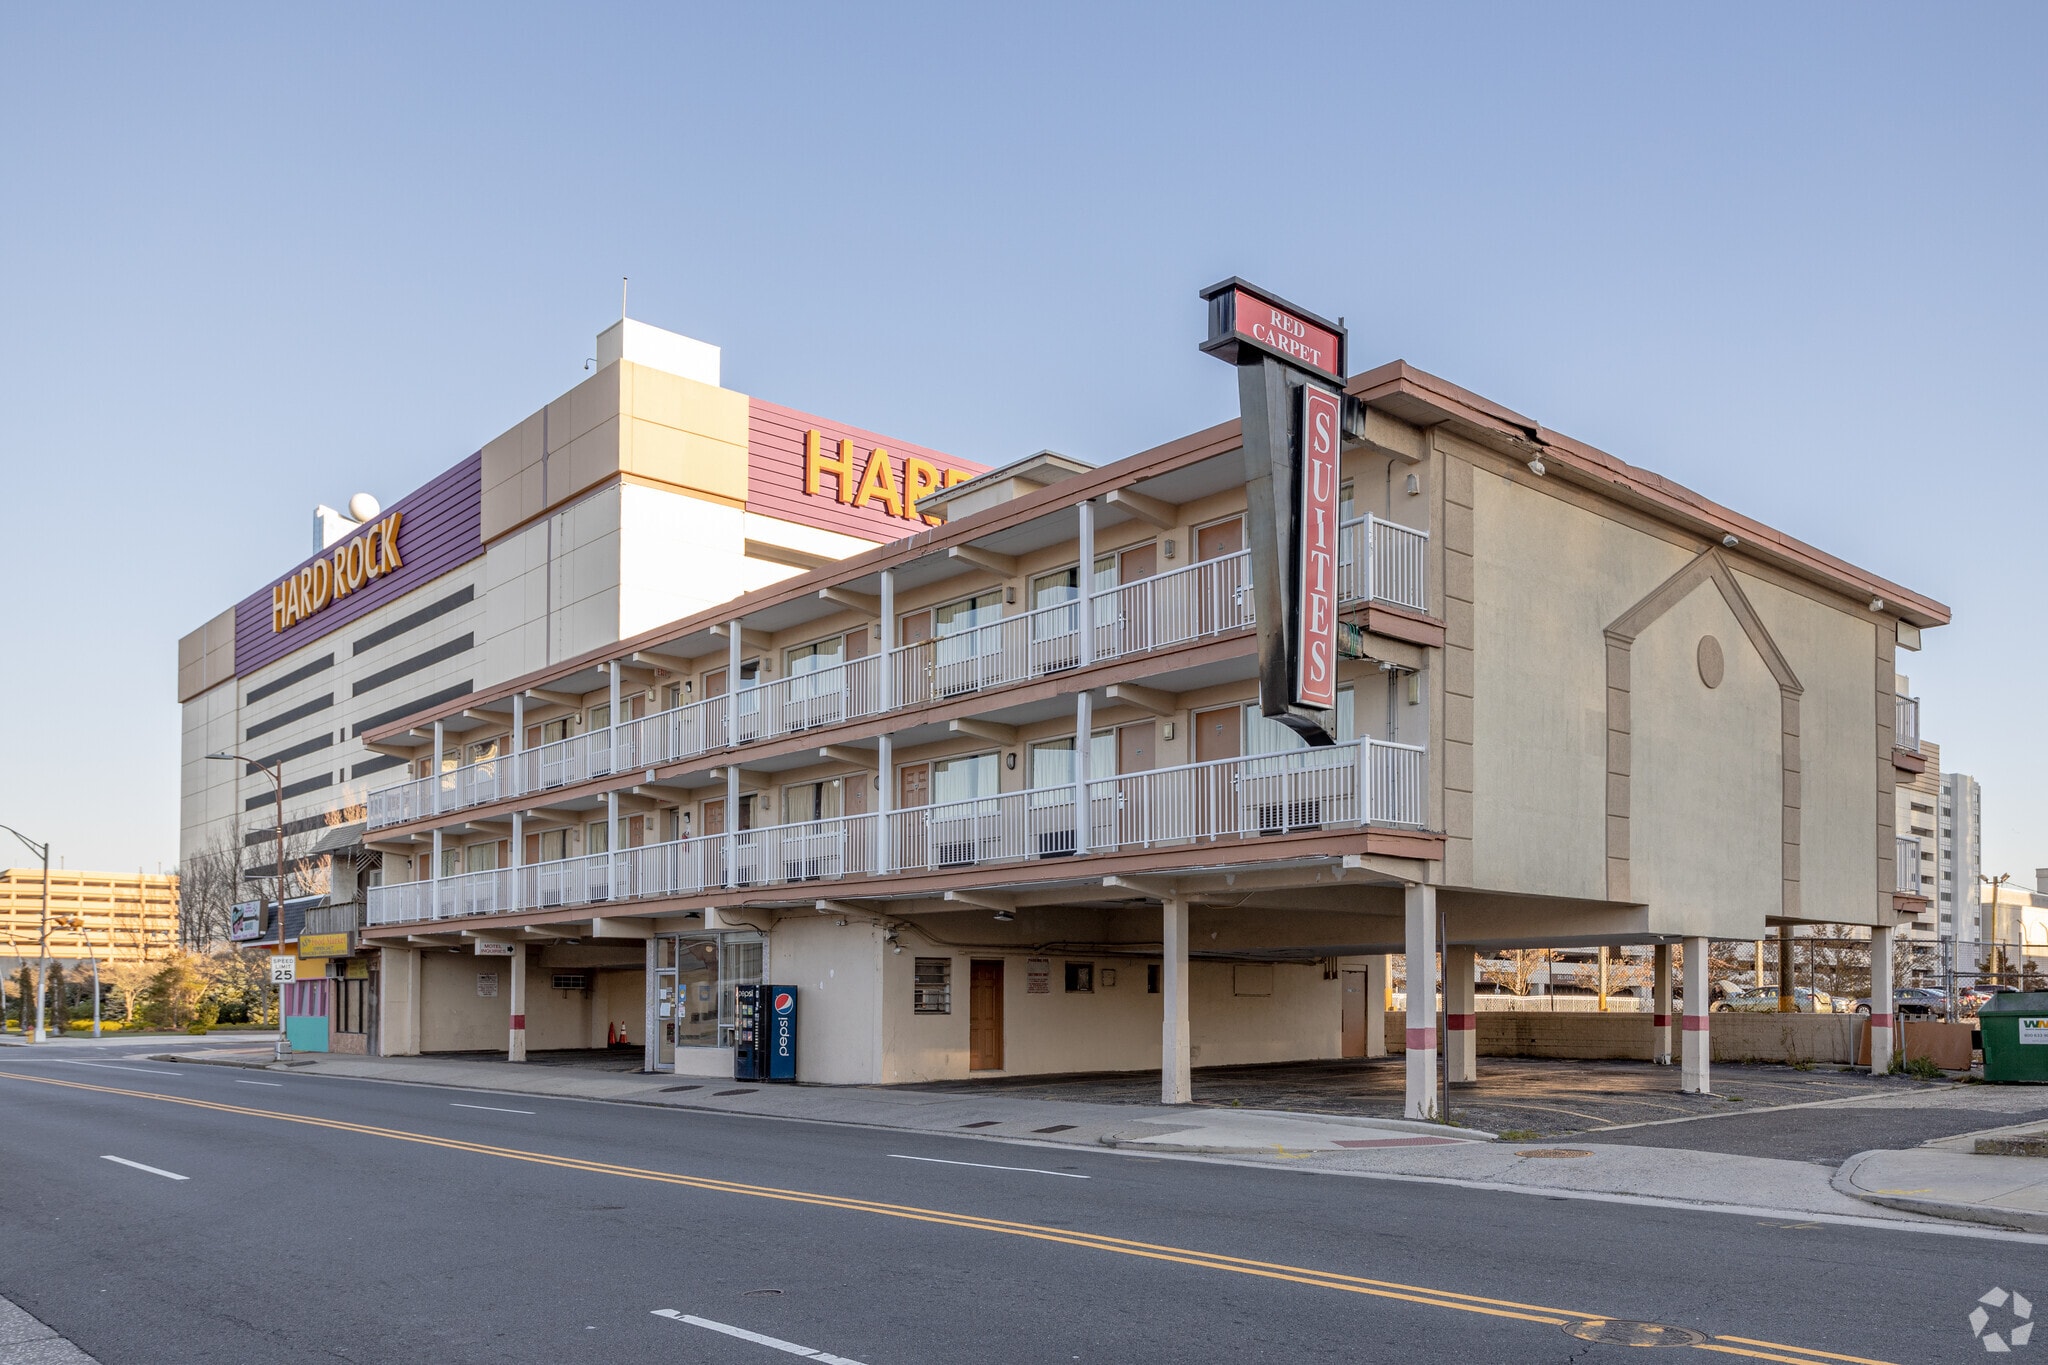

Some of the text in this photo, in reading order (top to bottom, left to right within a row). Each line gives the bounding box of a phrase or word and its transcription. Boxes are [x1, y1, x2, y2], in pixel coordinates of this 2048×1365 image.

[1270, 309, 1305, 338] RED
[1253, 323, 1322, 366] CARPET
[1309, 411, 1332, 682] SUITES
[272, 511, 404, 634] HARD ROCK
[311, 937, 324, 946] Food
[275, 970, 292, 980] 25
[738, 989, 754, 998] pepsi
[778, 1017, 790, 1056] pepsi
